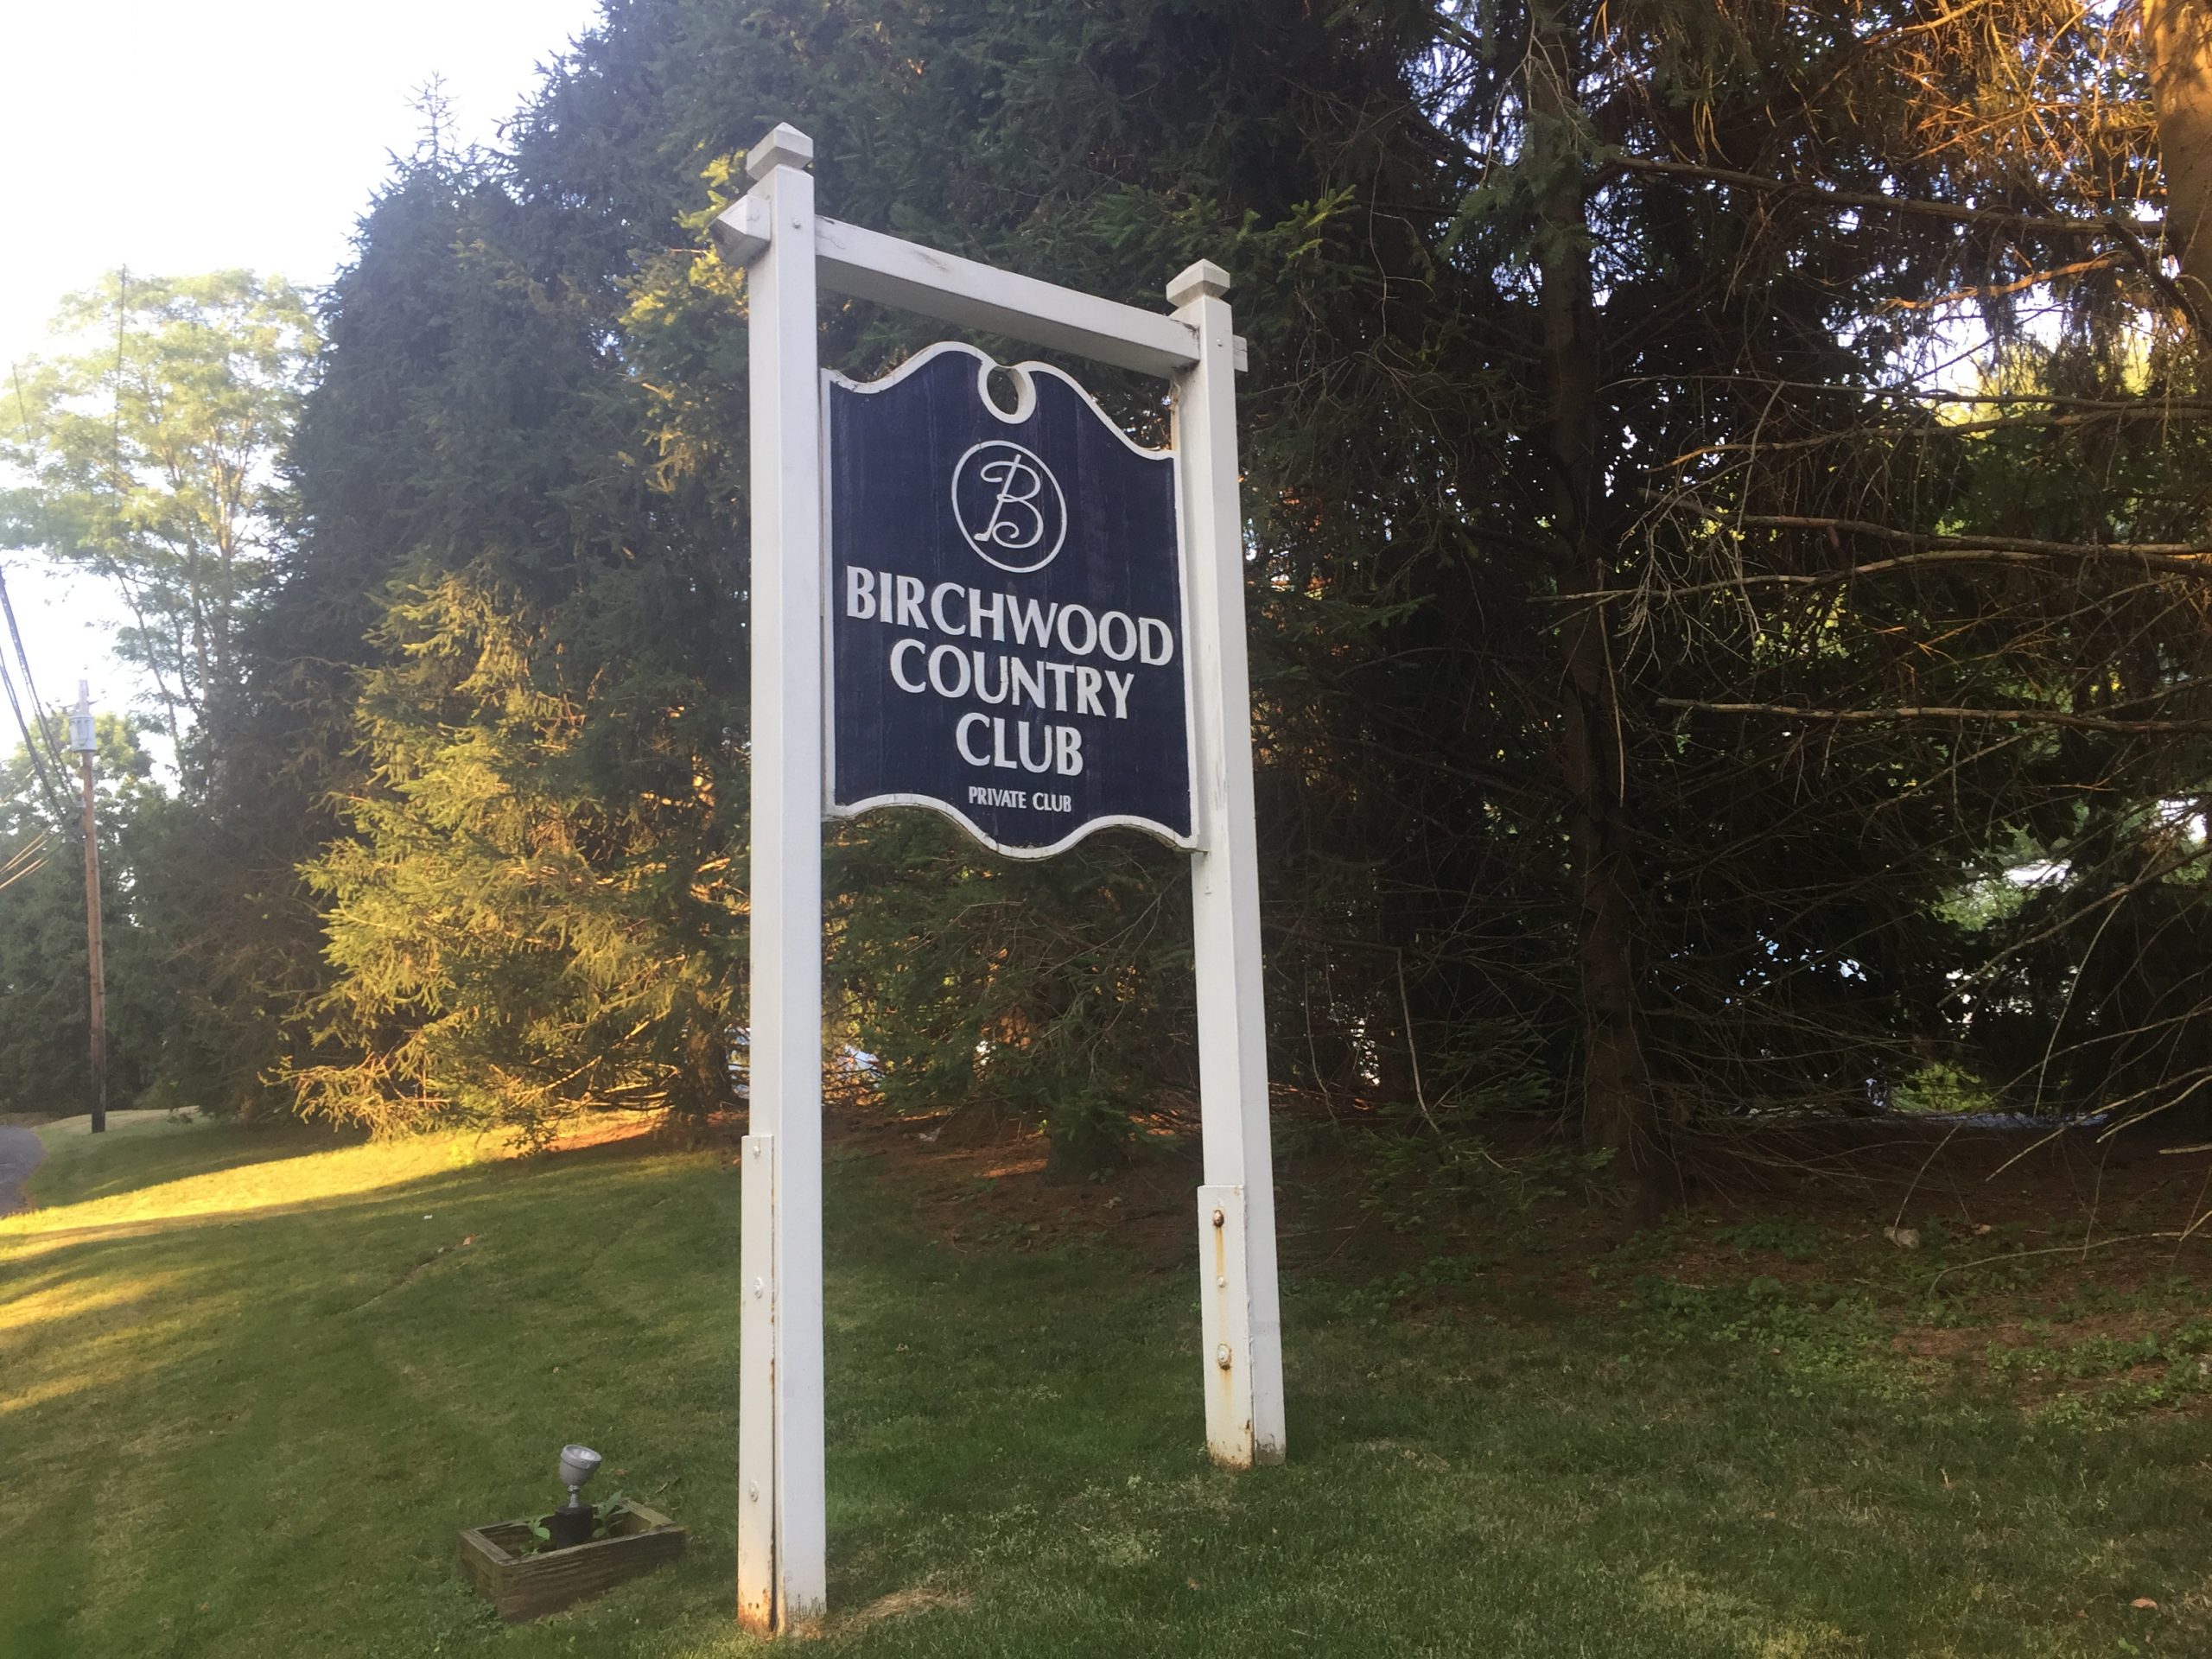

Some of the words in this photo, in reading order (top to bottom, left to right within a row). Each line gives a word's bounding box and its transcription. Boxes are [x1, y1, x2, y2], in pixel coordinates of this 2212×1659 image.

[974, 454, 1044, 549] B
[846, 565, 1174, 666] BIRCHWOOD
[889, 638, 1135, 720] COUNTRY
[956, 712, 1084, 776] CLUB
[968, 785, 1027, 809] PRIVATE
[1032, 791, 1072, 812] CLUB
